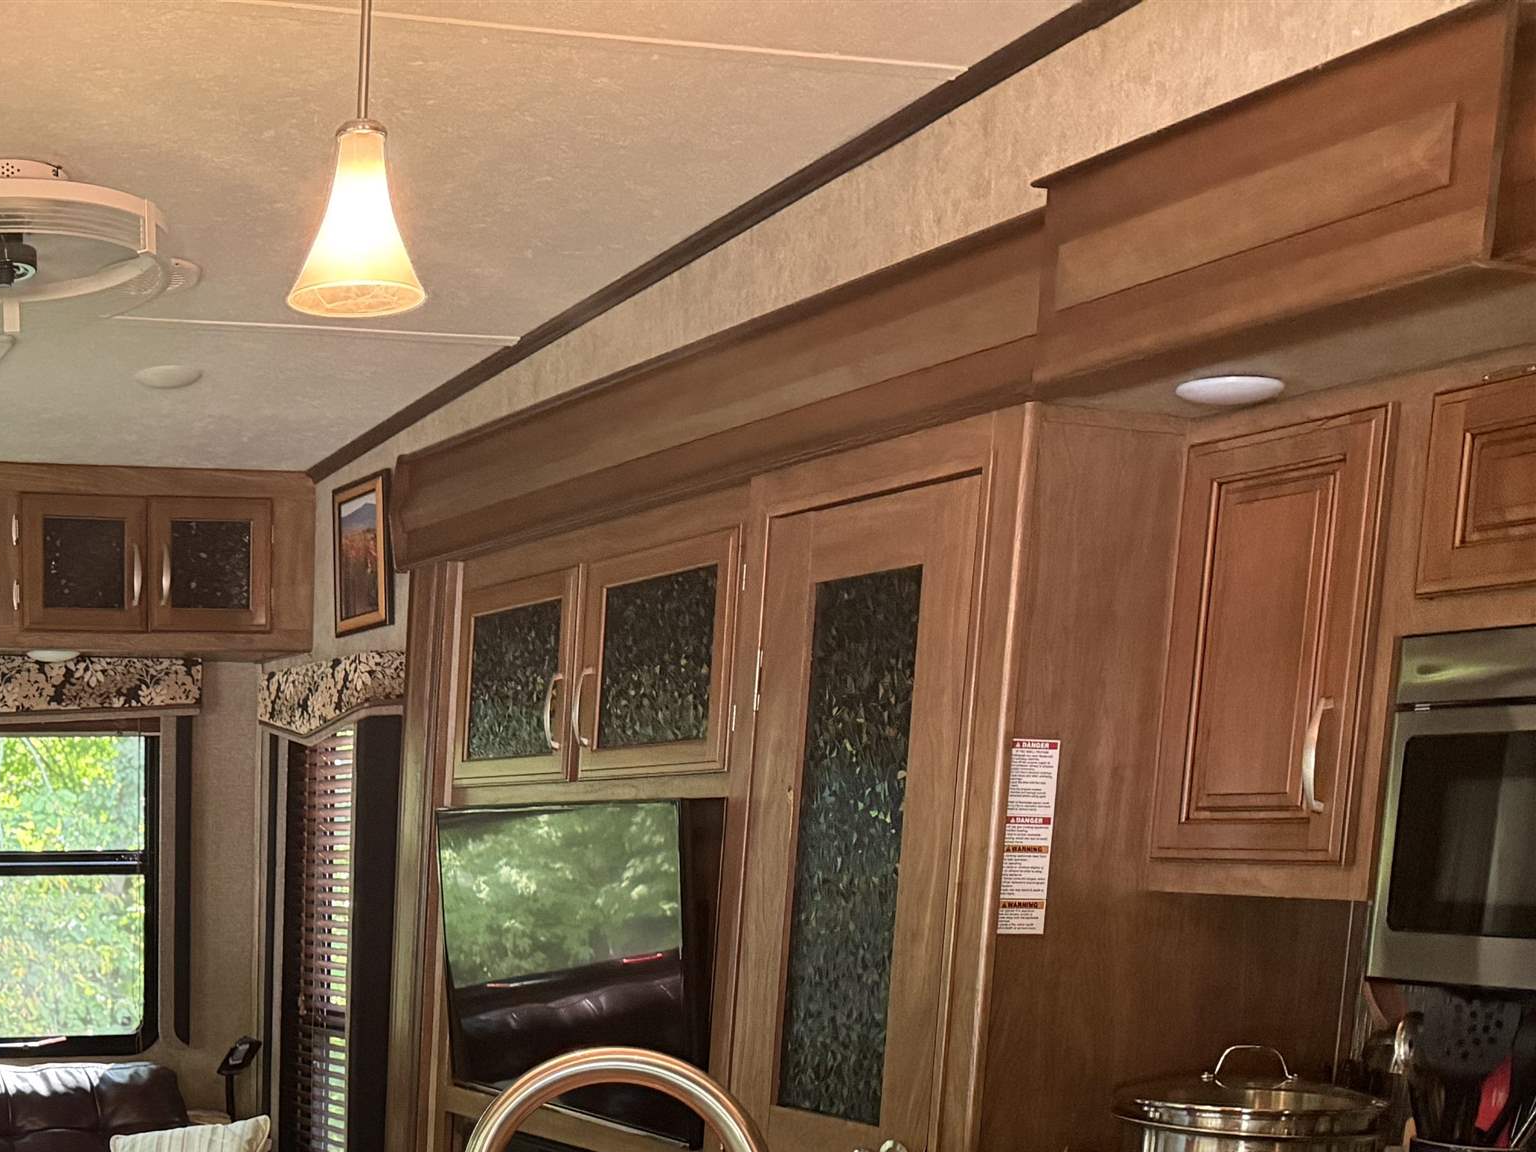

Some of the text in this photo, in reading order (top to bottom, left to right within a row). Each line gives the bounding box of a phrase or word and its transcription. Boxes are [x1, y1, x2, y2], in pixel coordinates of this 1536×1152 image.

[1022, 741, 1049, 749] DANGER
[1015, 816, 1043, 824] DANGER
[1012, 845, 1042, 853] WARNING
[1008, 901, 1038, 909] WARNING
